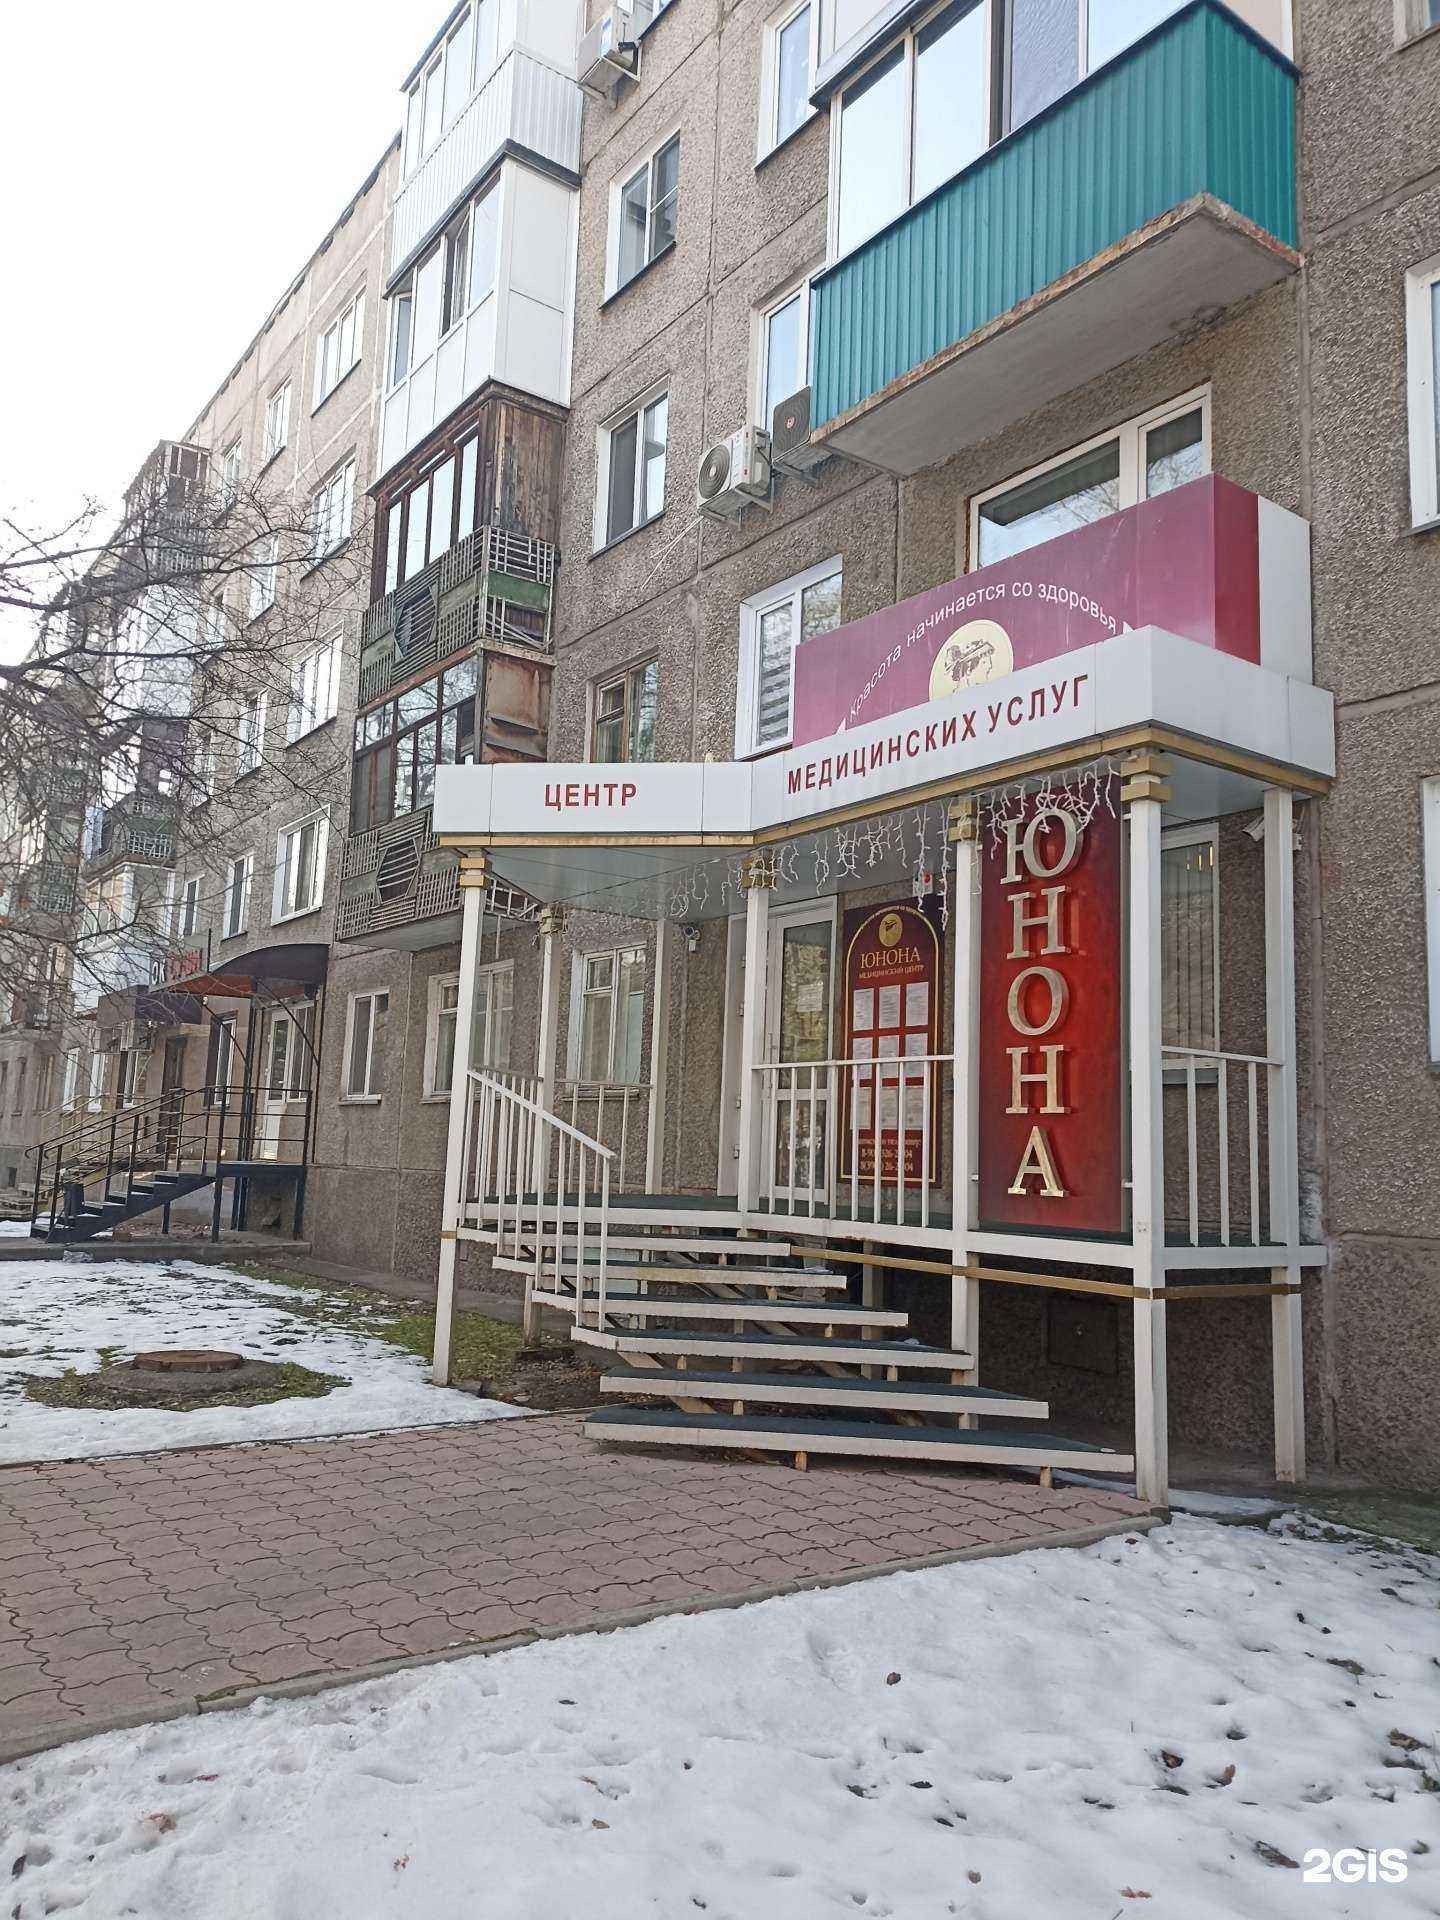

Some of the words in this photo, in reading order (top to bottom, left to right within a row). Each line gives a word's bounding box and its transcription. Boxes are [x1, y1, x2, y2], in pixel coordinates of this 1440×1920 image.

[906, 583, 1006, 648] начинается
[1011, 581, 1034, 598] со
[1037, 583, 1117, 635] здоровья
[787, 710, 977, 795] МЕДИЦИНСКИХ
[987, 673, 1089, 734] УСЛУГ
[544, 783, 638, 812] ЦЕНТР
[860, 946, 921, 969] ЮНОНА
[999, 807, 1086, 1198] ЮНОНА
